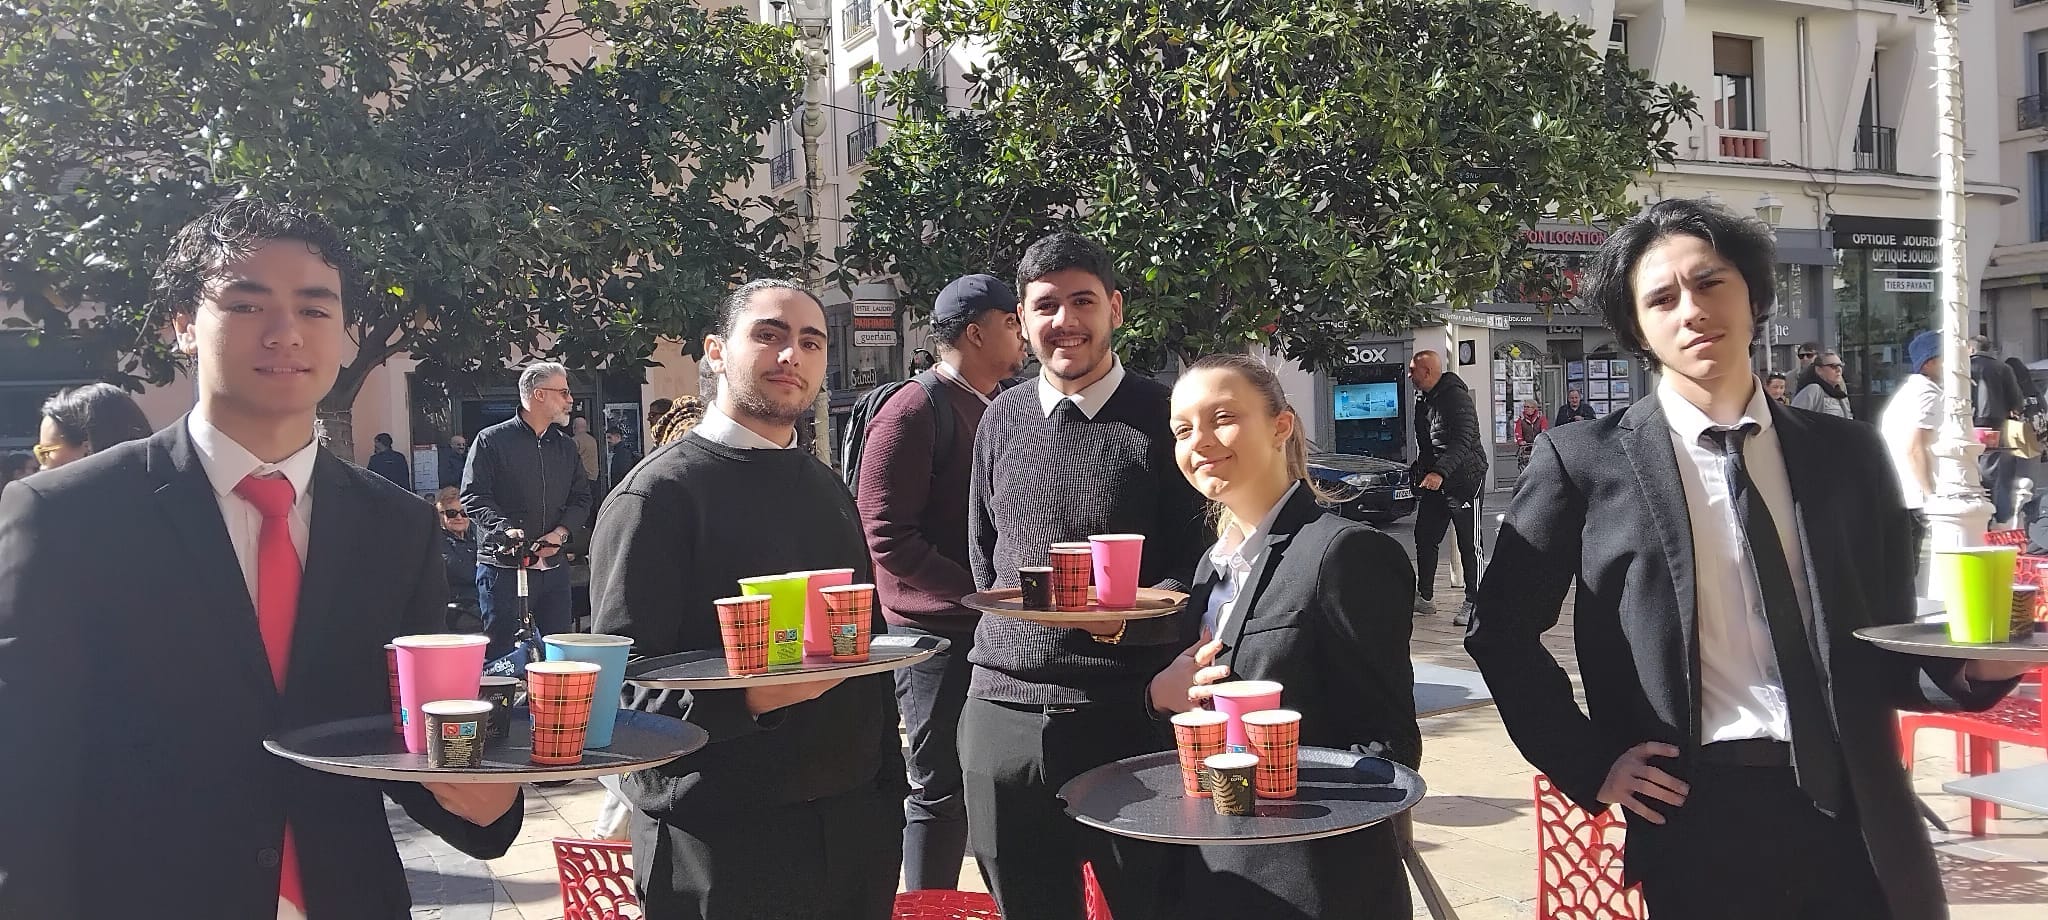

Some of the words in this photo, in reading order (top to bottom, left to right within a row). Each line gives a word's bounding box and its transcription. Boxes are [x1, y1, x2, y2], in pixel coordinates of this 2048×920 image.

[1549, 230, 1606, 246] LOCATION
[1853, 234, 1897, 245] OPTIQUE
[1872, 249, 1907, 264] OPTIQUE
[1886, 280, 1905, 290] TIERS
[1906, 281, 1932, 290] PAYANT
[860, 332, 892, 344] guerlain
